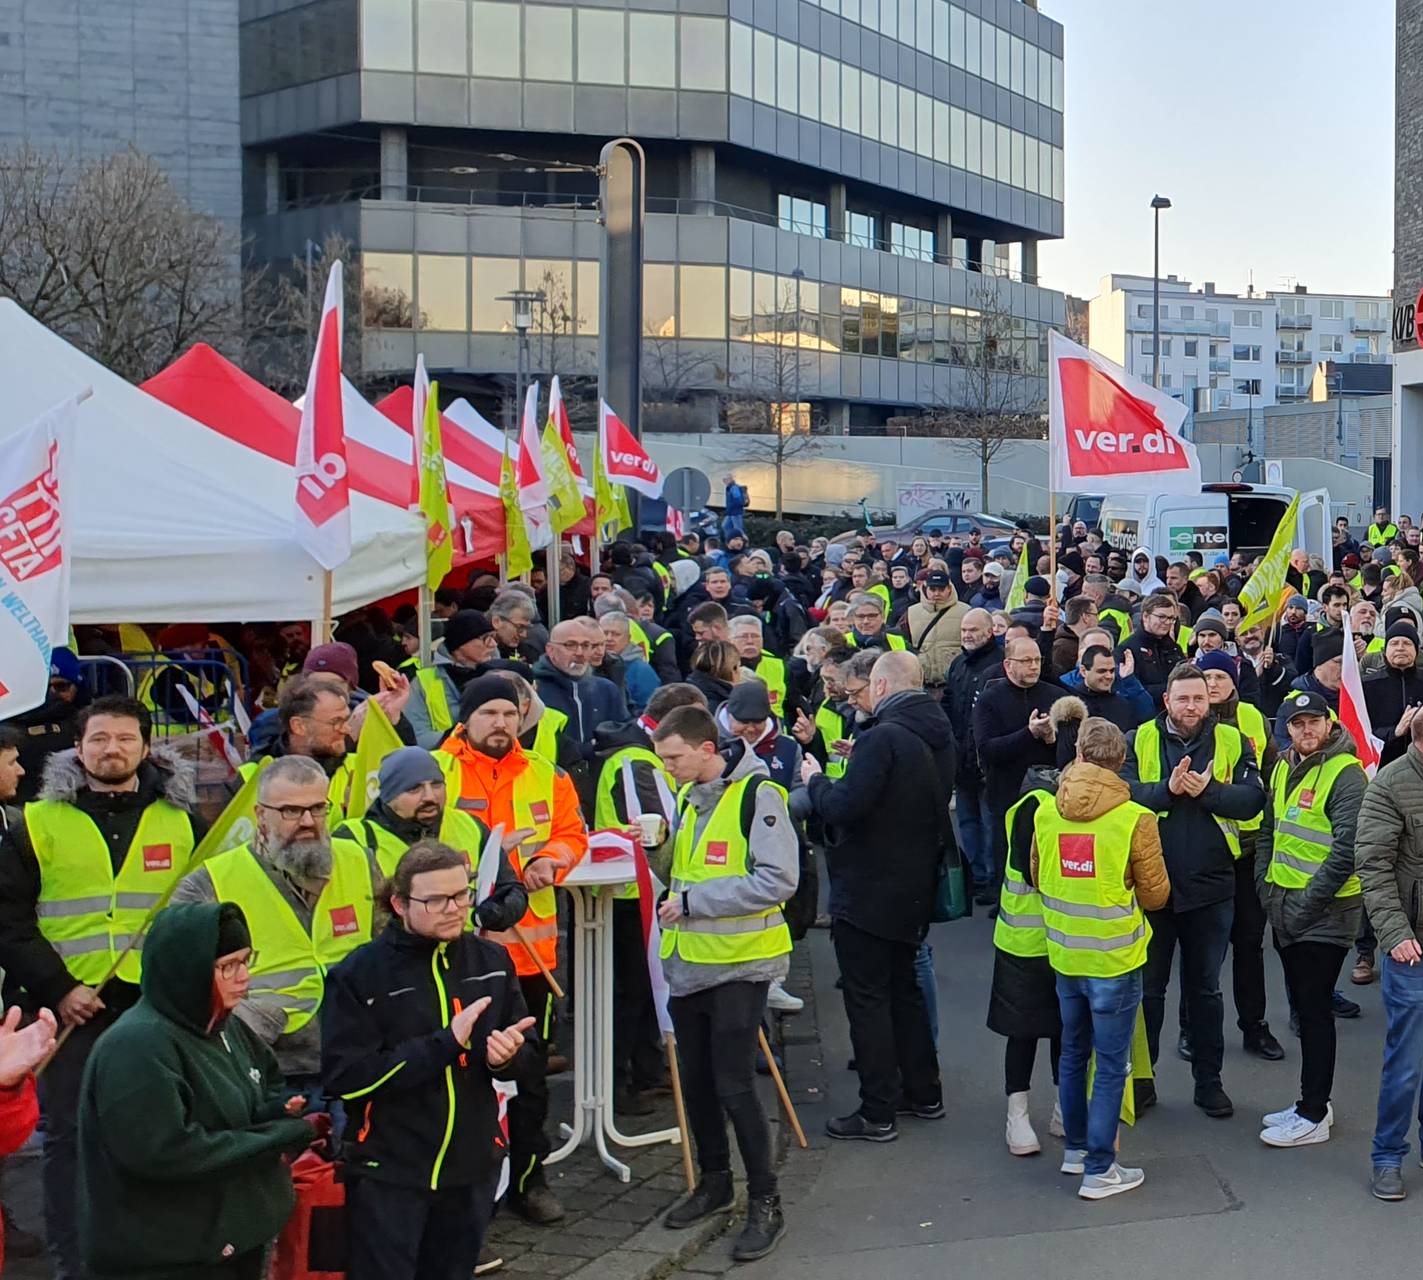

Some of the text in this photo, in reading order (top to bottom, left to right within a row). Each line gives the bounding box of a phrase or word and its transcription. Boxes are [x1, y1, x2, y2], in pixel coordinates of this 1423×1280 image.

[1392, 304, 1415, 340] KVB
[1074, 428, 1176, 455] ver.di
[610, 450, 656, 475] ver.di
[1061, 859, 1093, 874] ver.di
